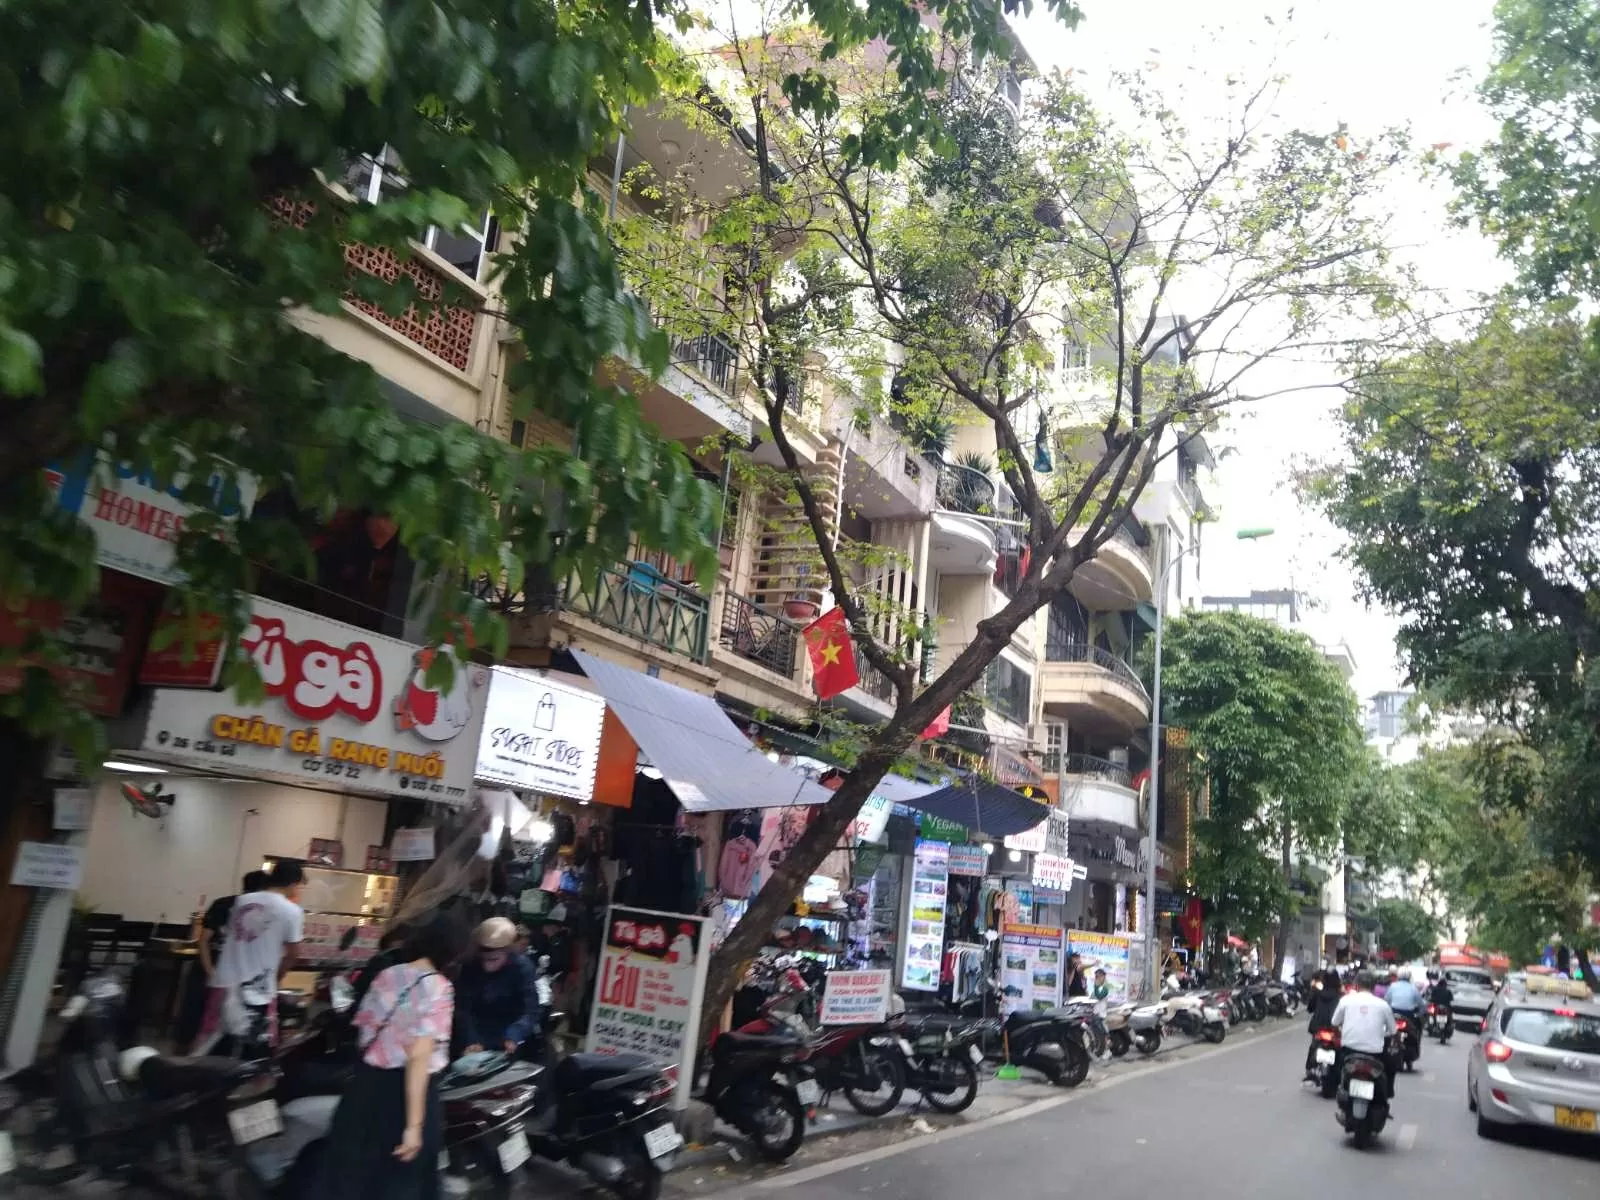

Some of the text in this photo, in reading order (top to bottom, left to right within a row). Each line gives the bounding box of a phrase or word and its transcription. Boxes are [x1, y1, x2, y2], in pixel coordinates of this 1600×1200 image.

[291, 645, 377, 713] gà
[211, 714, 285, 748] CHÂN
[329, 737, 390, 769] RANG
[394, 750, 446, 779] MUỐI
[928, 814, 964, 832] VEGAN
